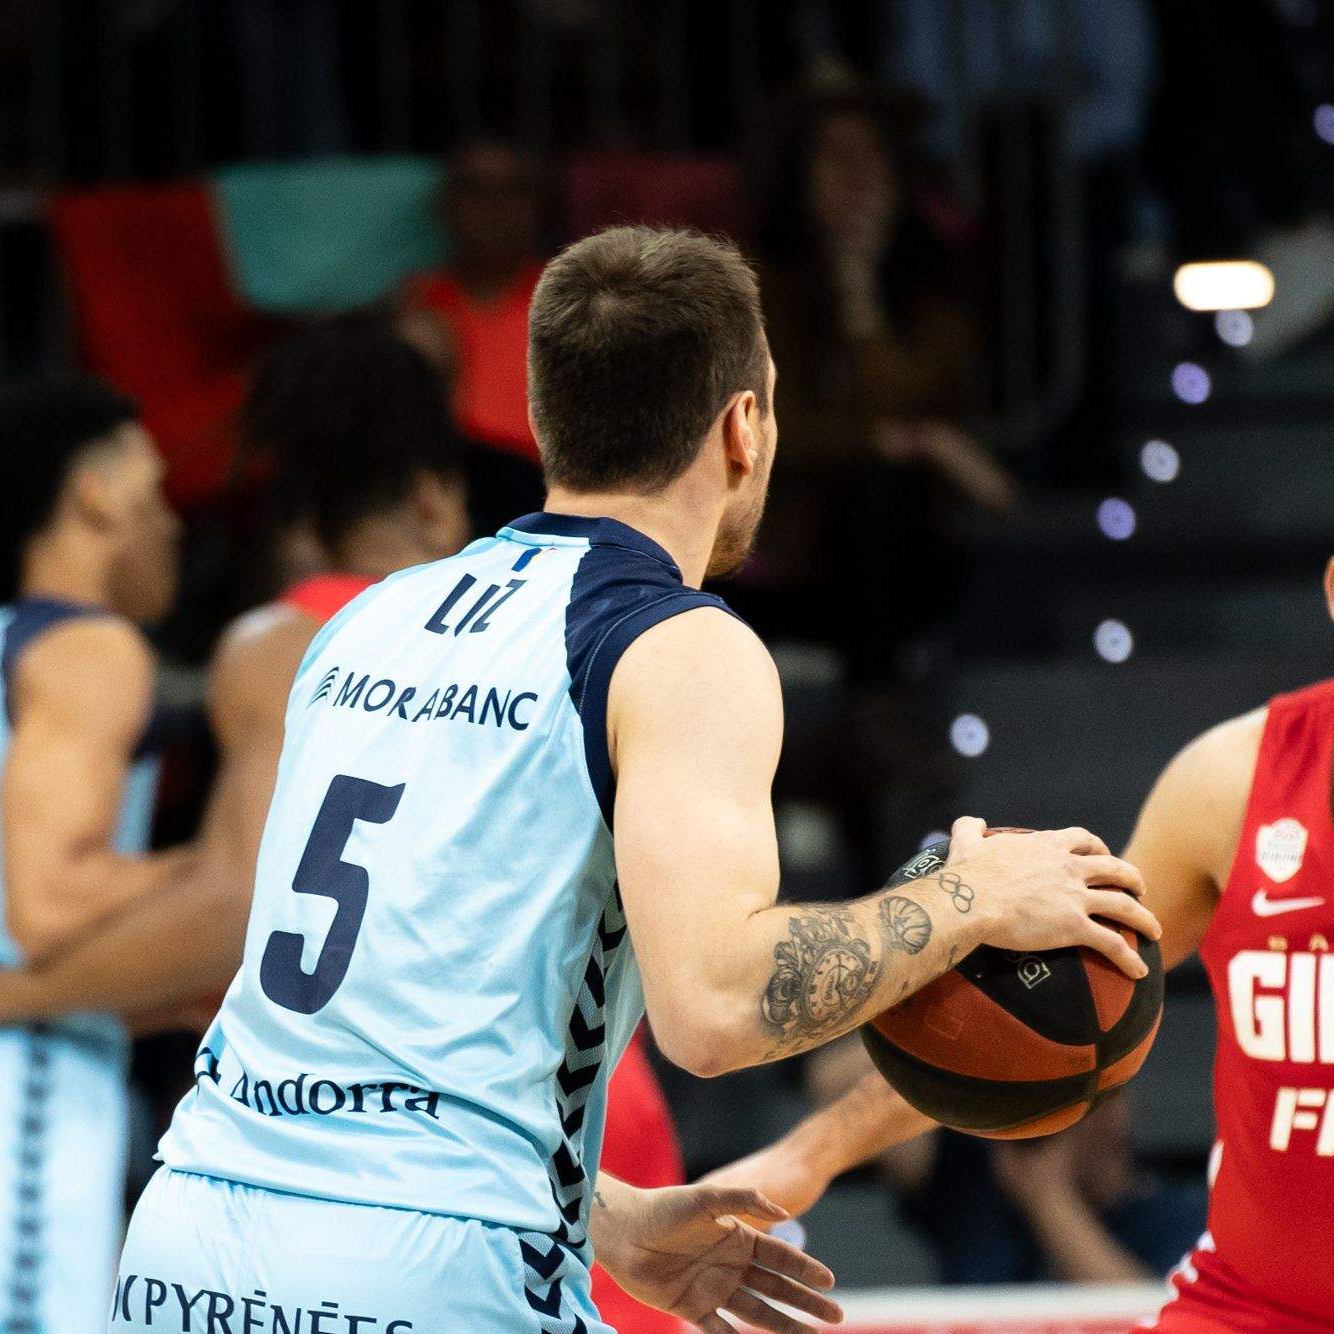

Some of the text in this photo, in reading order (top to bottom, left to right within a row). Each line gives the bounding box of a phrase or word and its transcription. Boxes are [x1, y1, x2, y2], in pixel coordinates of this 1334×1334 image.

[331, 671, 539, 731] MORABANC
[259, 773, 406, 1015] 5
[229, 1072, 441, 1120] Andorra
